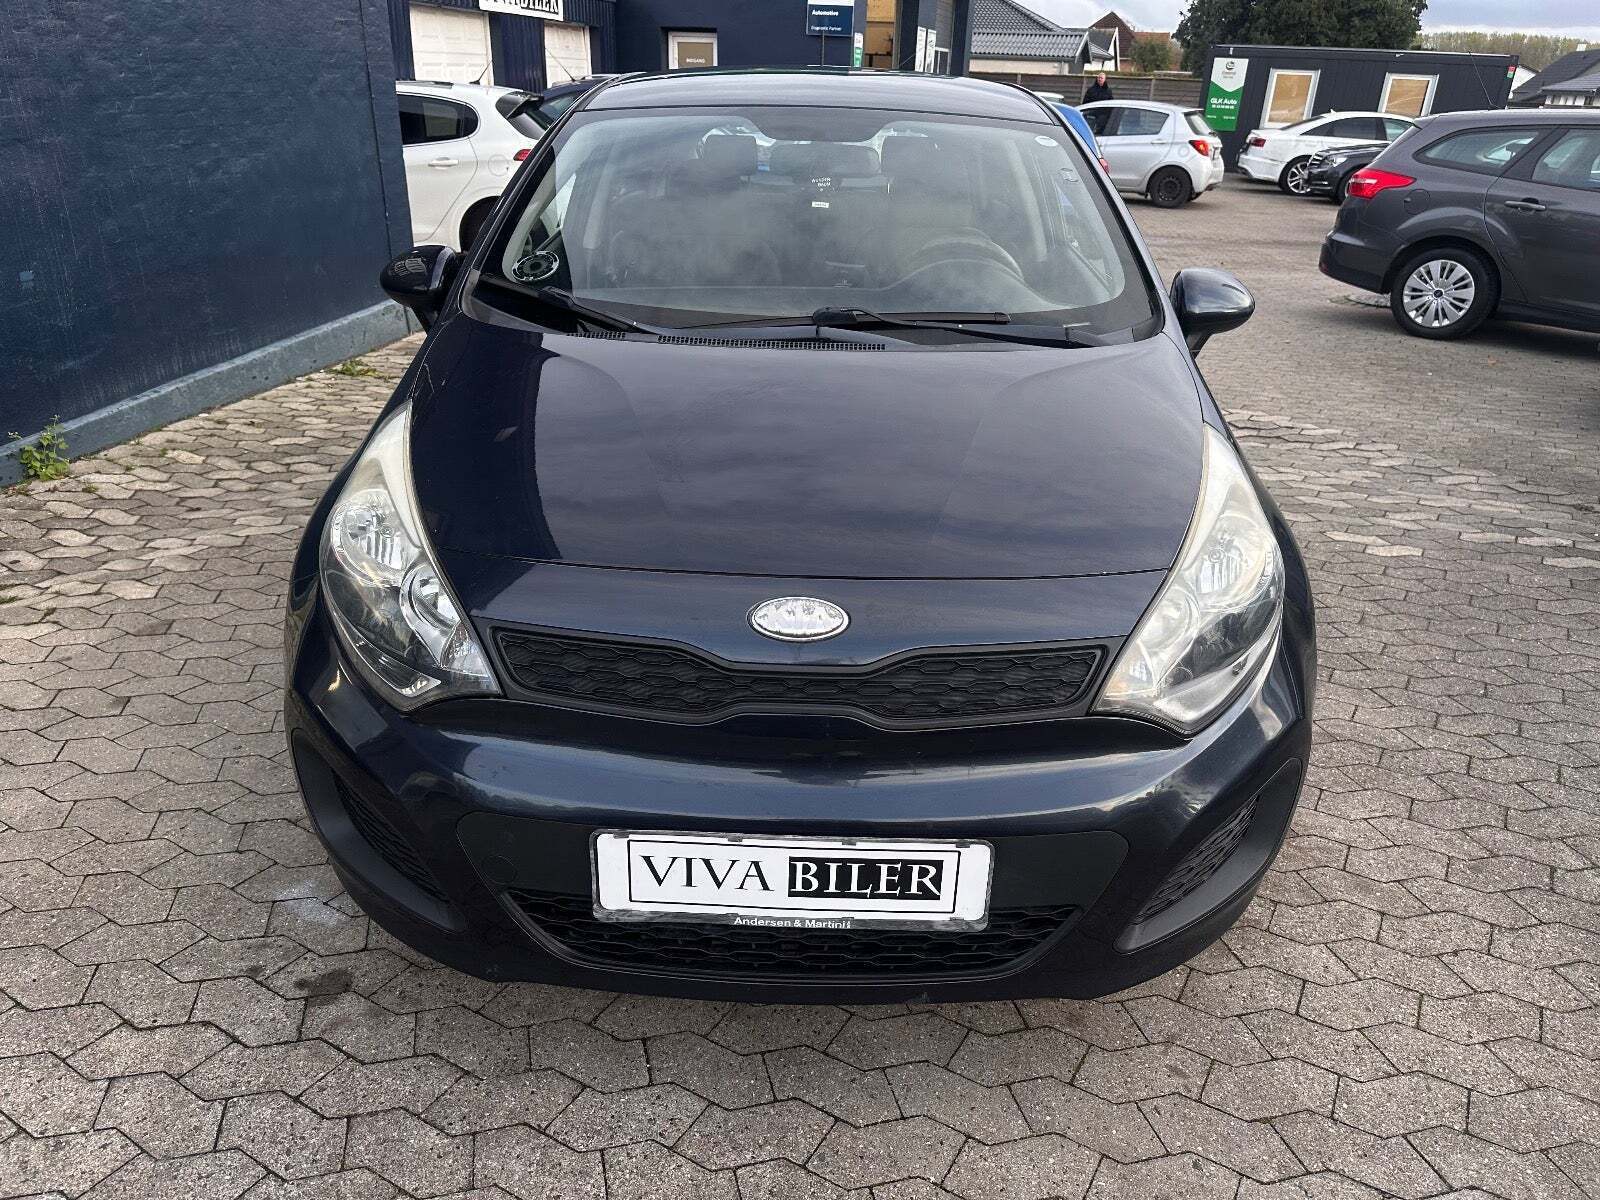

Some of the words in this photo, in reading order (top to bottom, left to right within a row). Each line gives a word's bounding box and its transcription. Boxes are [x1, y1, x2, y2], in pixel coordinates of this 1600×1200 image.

[640, 855, 775, 891] VIVA
[790, 861, 941, 898] BILER
[734, 917, 791, 927] Andersen
[793, 919, 802, 928] &
